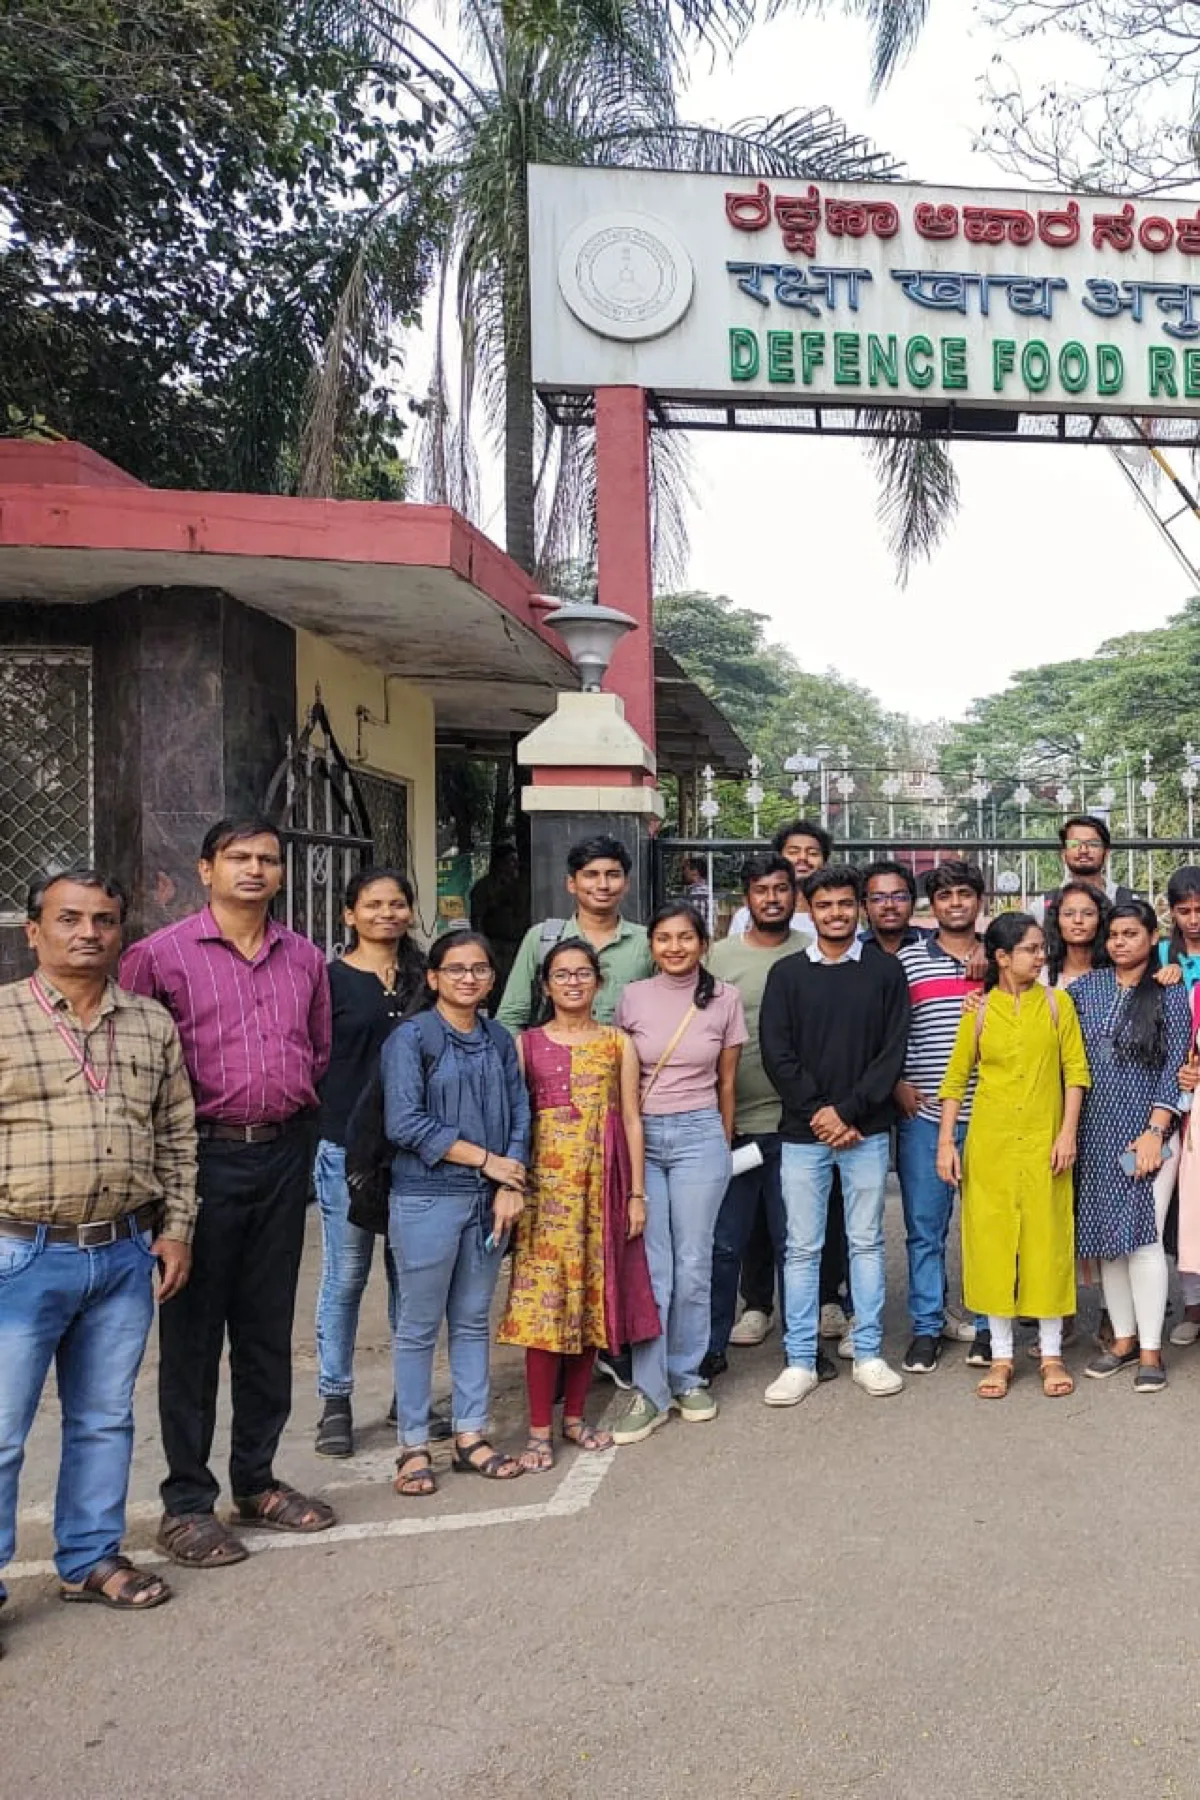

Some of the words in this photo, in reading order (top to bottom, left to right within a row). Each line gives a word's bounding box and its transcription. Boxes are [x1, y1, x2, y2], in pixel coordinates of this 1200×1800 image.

[725, 182, 899, 258] ರಕ್ಷಣಾ
[914, 200, 1080, 248] ಆಹಾರ
[725, 261, 873, 317] रक्षा
[890, 269, 1068, 320] खाद्य
[728, 328, 968, 389] DEFENCE
[992, 339, 1124, 395] FOOD
